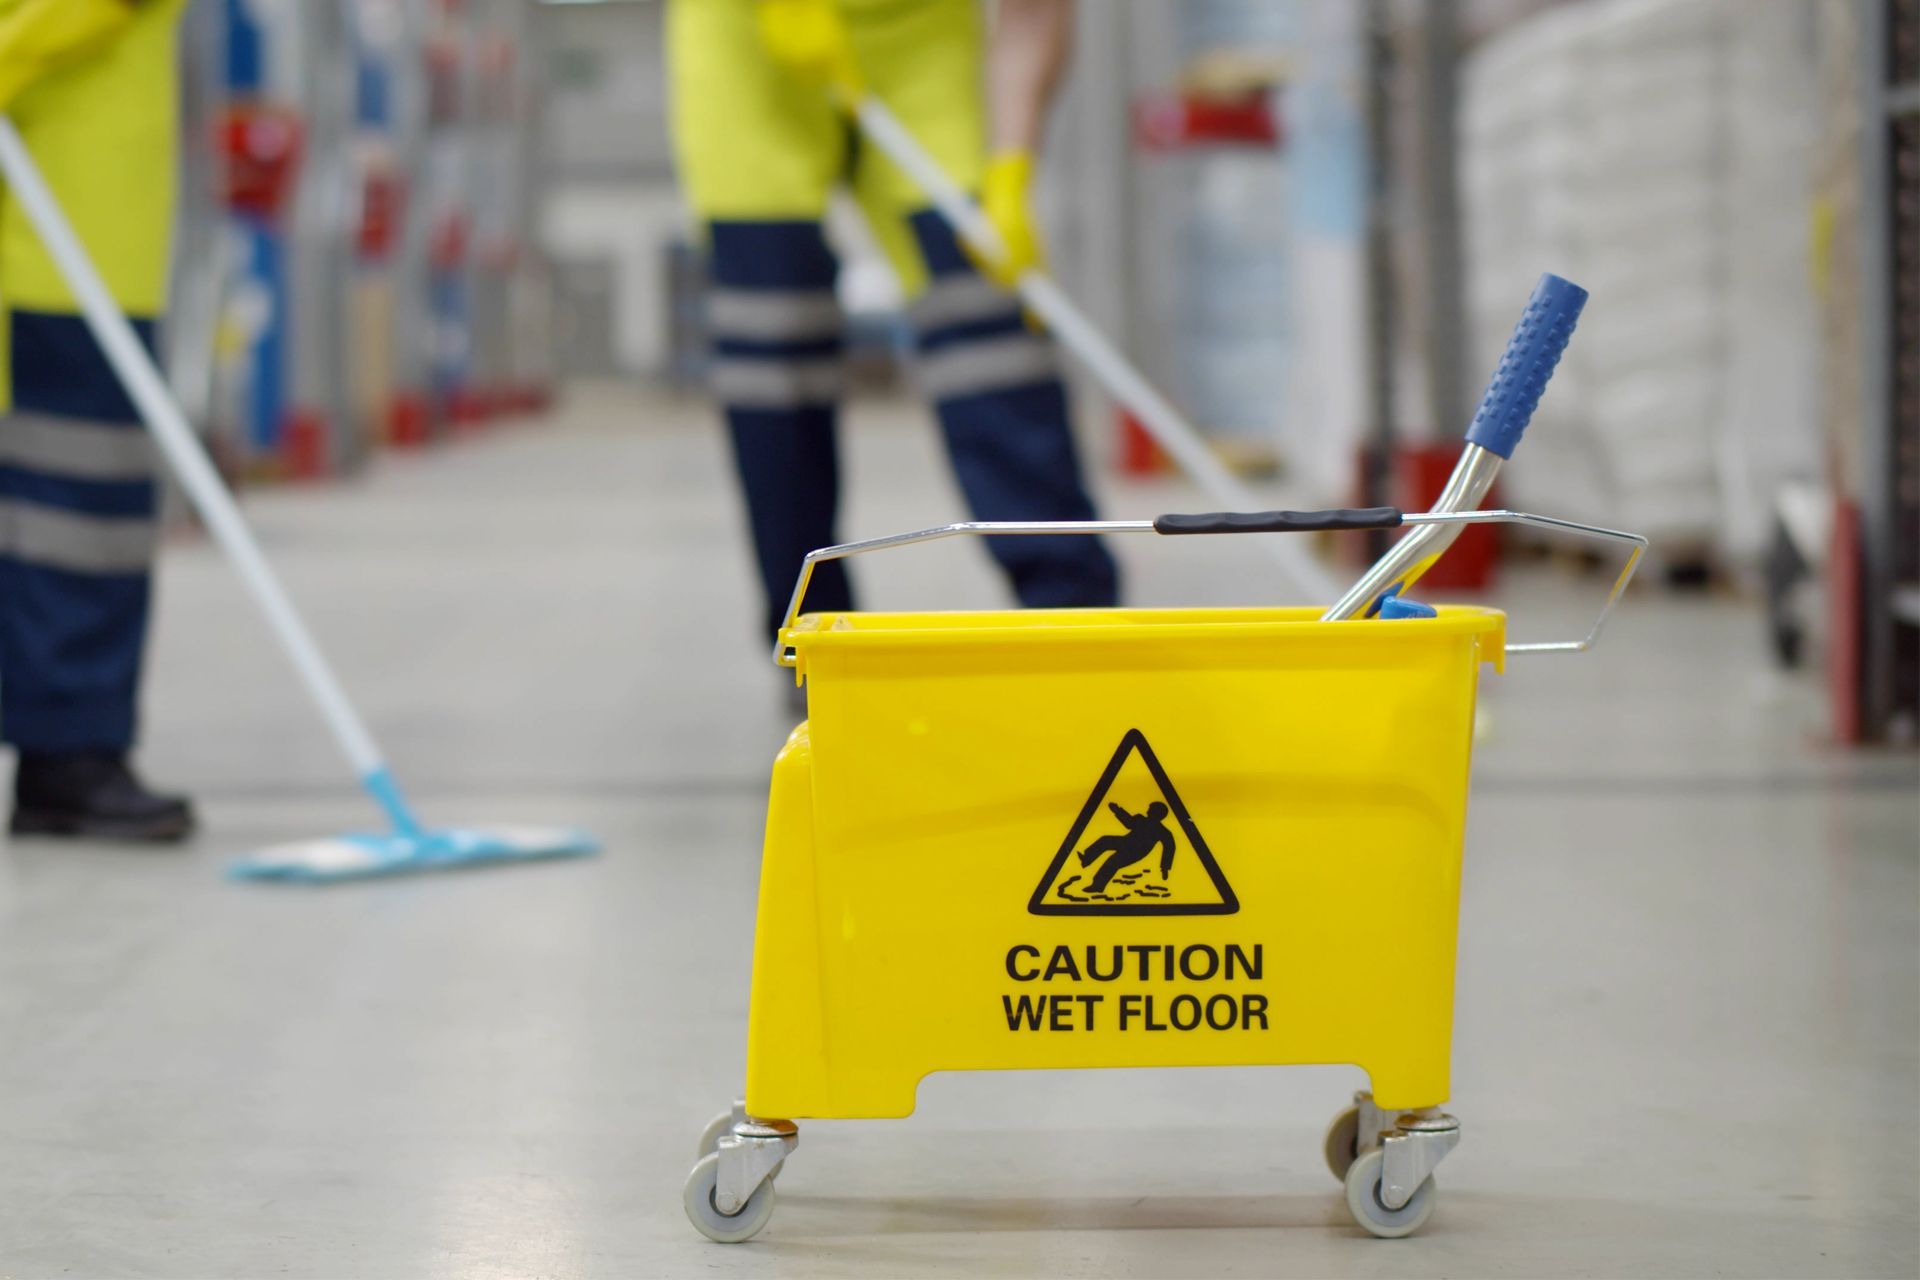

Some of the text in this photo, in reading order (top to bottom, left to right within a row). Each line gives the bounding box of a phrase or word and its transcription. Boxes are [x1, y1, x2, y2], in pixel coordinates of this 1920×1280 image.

[1005, 943, 1263, 982] CAUTION
[1002, 993, 1269, 1032] WET FLOOR
